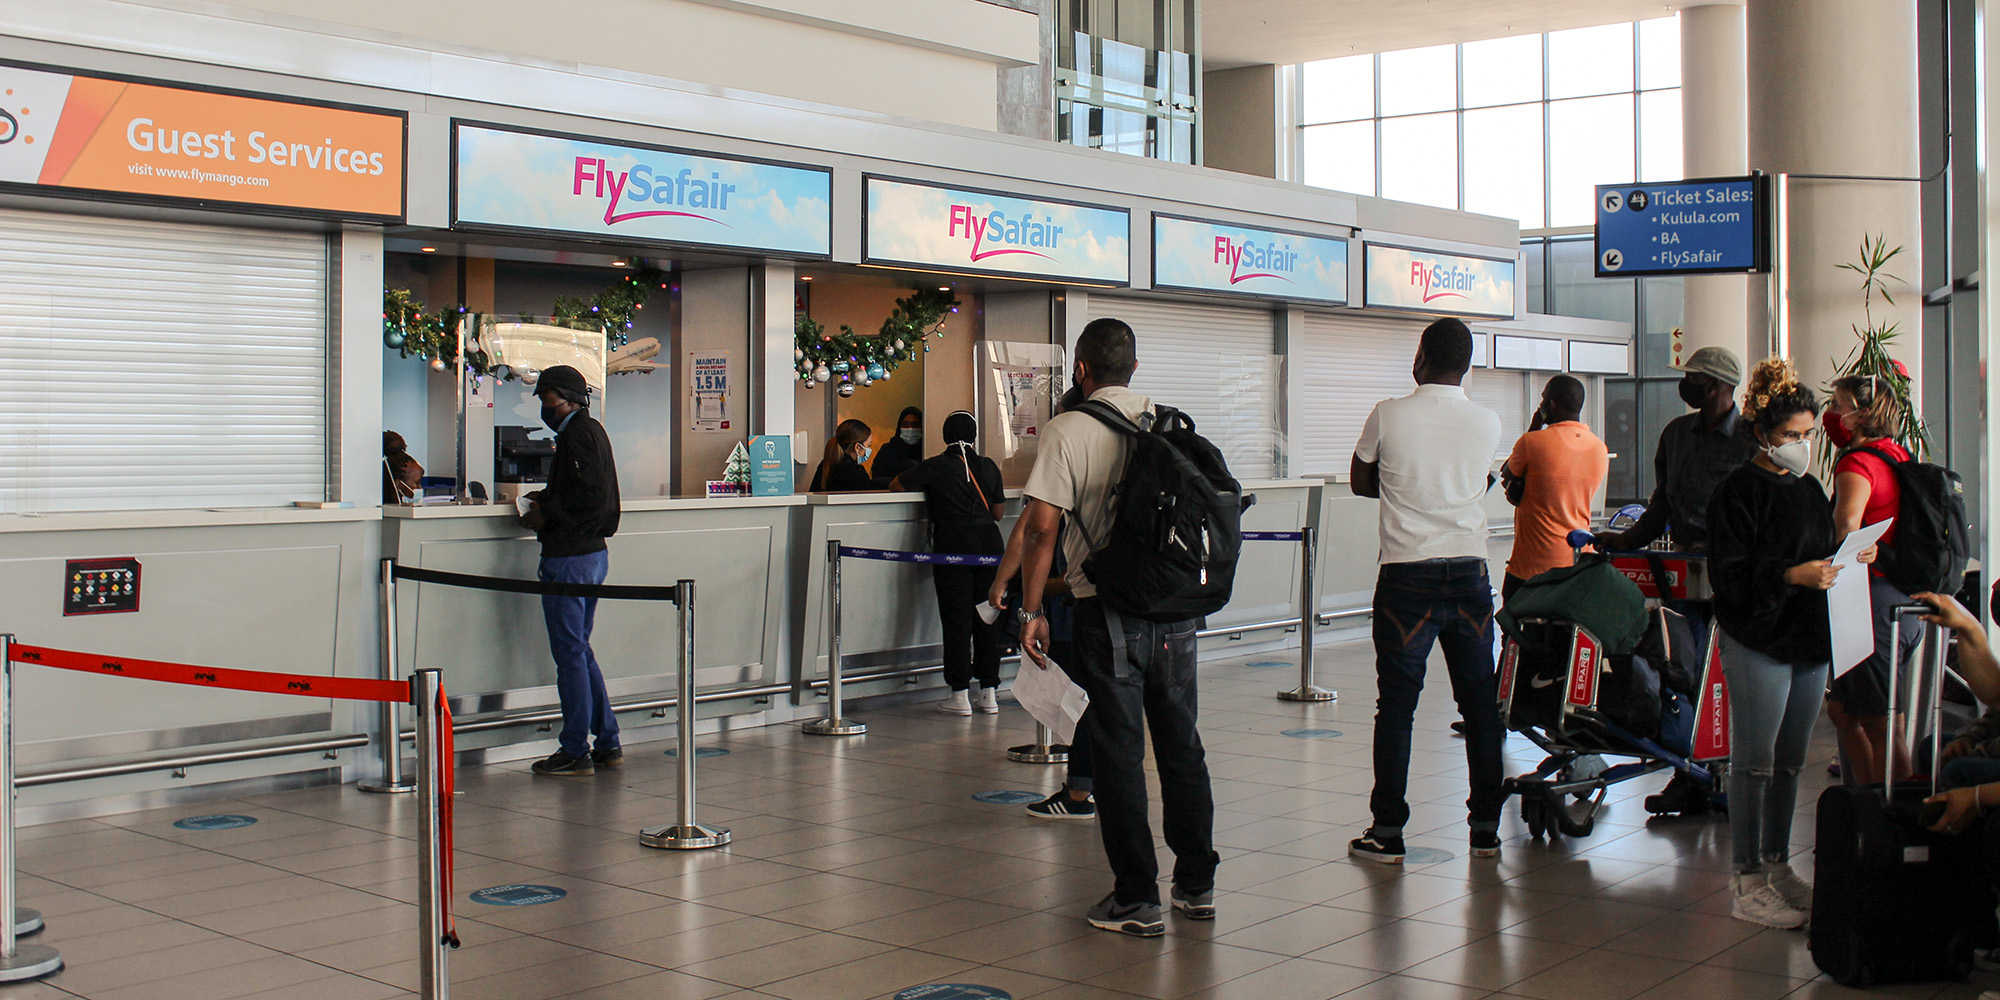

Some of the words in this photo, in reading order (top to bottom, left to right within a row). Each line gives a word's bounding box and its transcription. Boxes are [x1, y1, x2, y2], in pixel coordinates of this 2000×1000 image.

[126, 117, 236, 161] Guest
[248, 130, 384, 176] Services
[128, 163, 153, 176] visit
[155, 167, 269, 187] www.flymango.com
[573, 156, 736, 226] FlySafair
[1652, 190, 1702, 206] Ticket
[1706, 187, 1754, 204] Sales:
[1661, 211, 1740, 225] Kulula.com
[949, 204, 1064, 263] FlySafair
[1661, 232, 1680, 245] BA
[1214, 236, 1298, 285] FlySafair
[1661, 250, 1723, 268] FlySafair
[1411, 261, 1476, 304] FlySafair
[696, 376, 712, 389] 1.5
[715, 376, 726, 389] M
[1577, 660, 1589, 690] SPAR
